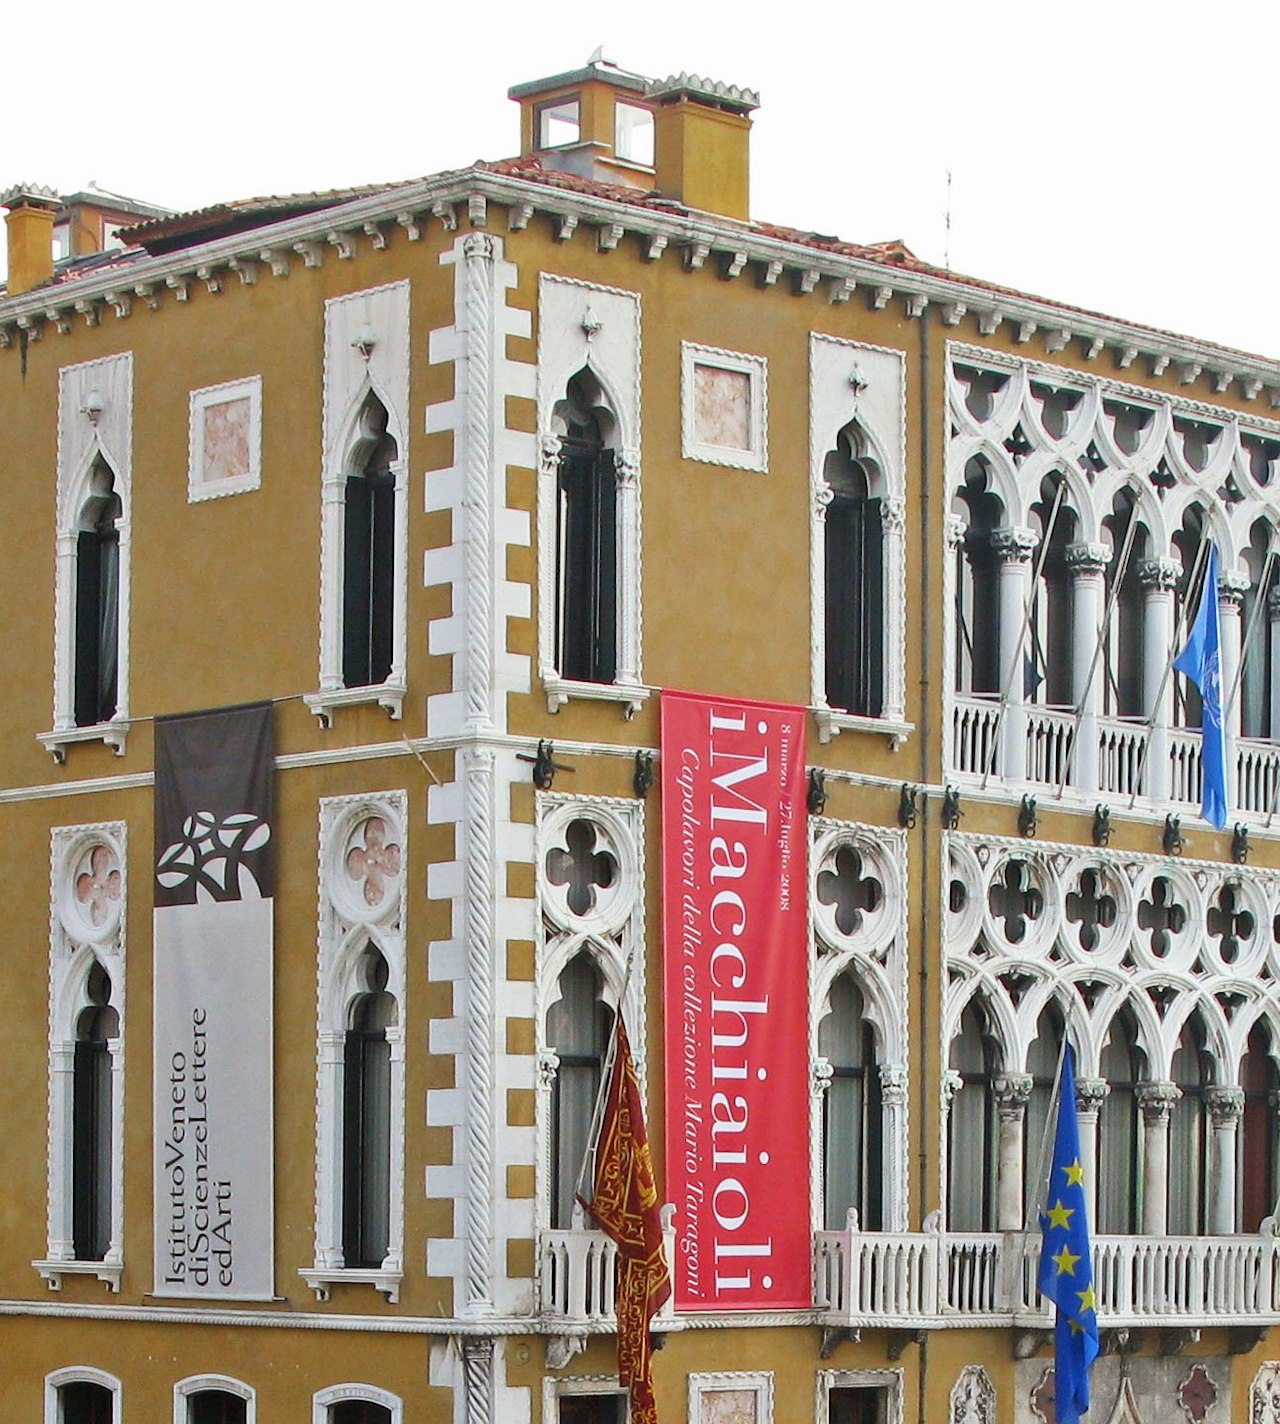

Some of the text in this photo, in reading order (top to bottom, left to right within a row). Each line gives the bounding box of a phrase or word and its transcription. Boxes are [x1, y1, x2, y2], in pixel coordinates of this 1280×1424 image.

[780, 723, 792, 734] 8
[780, 738, 790, 787] marzo
[780, 872, 790, 911] 2008
[676, 748, 705, 1297] Capolavori della collezione Mario Taragoni
